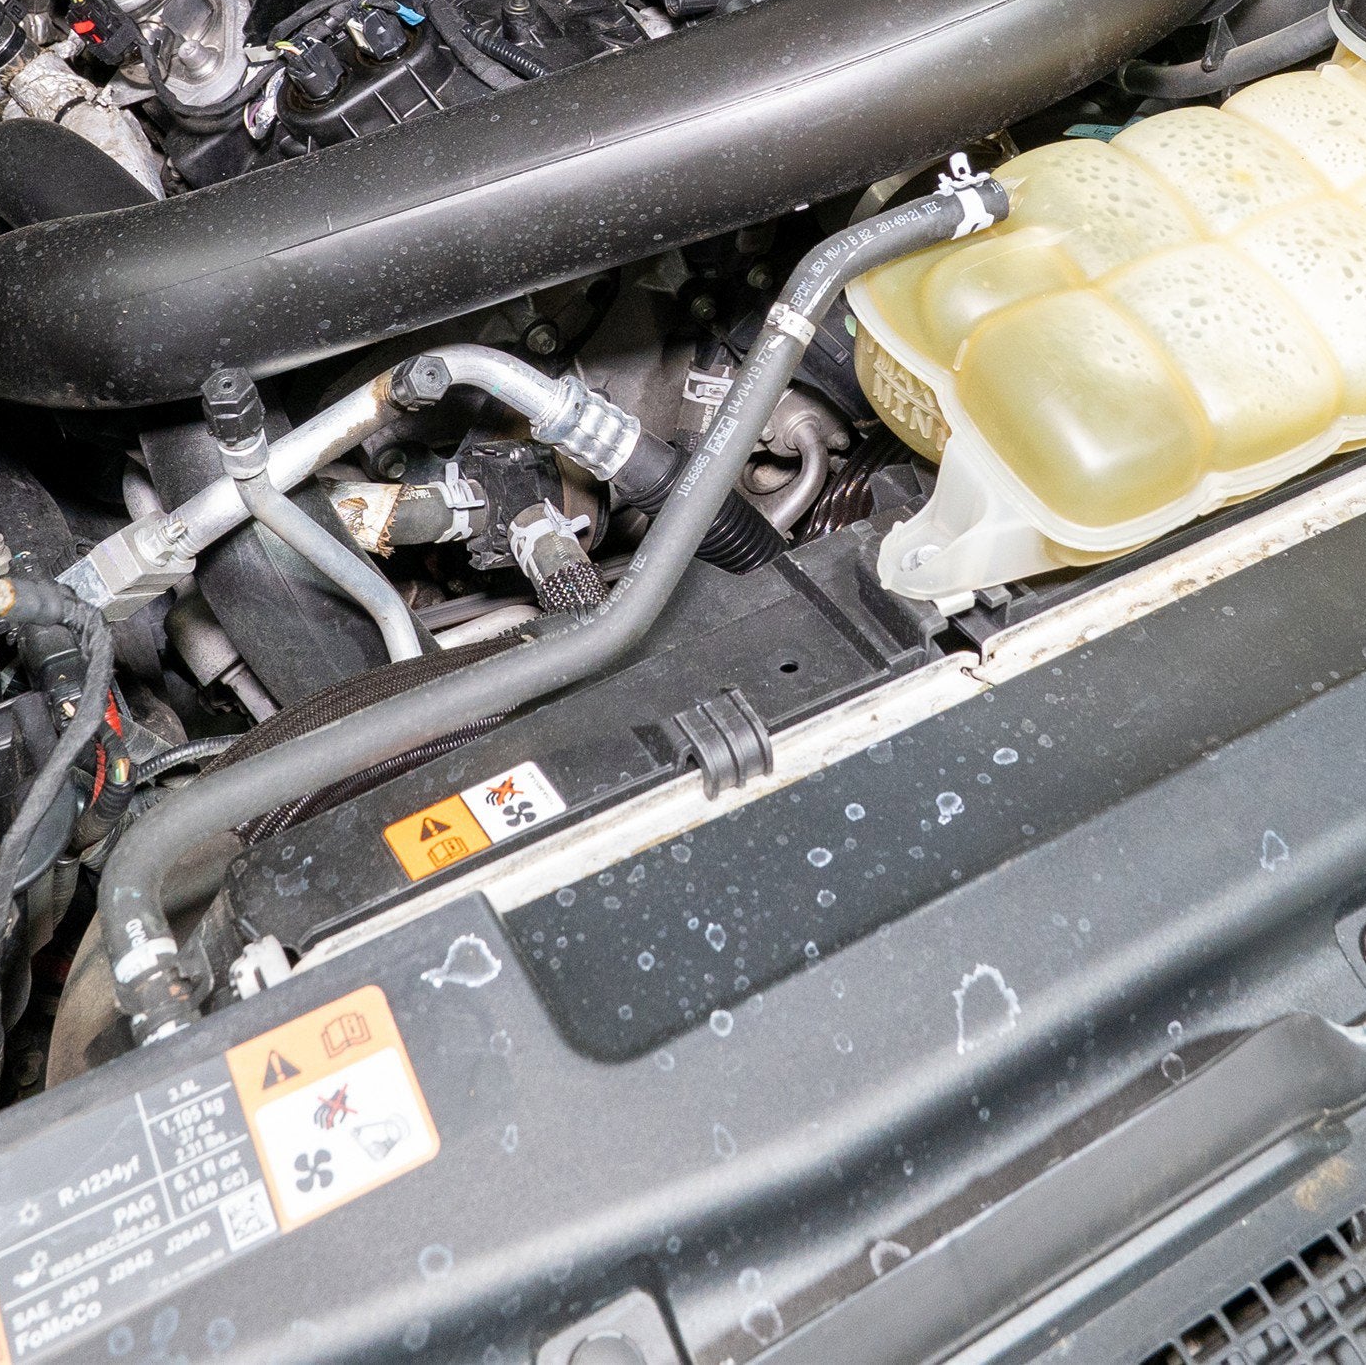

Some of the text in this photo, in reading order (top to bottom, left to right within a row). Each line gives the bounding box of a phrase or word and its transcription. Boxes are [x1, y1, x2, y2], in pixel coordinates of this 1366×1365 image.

[876, 200, 941, 232] 20:49:21 TEC
[677, 451, 711, 498] 1036865
[726, 364, 763, 415] 04/04/19
[629, 552, 648, 573] TEC
[56, 1153, 144, 1212] R-1234yf
[111, 1191, 158, 1229] PAG
[13, 1294, 104, 1356] FoMoCo
